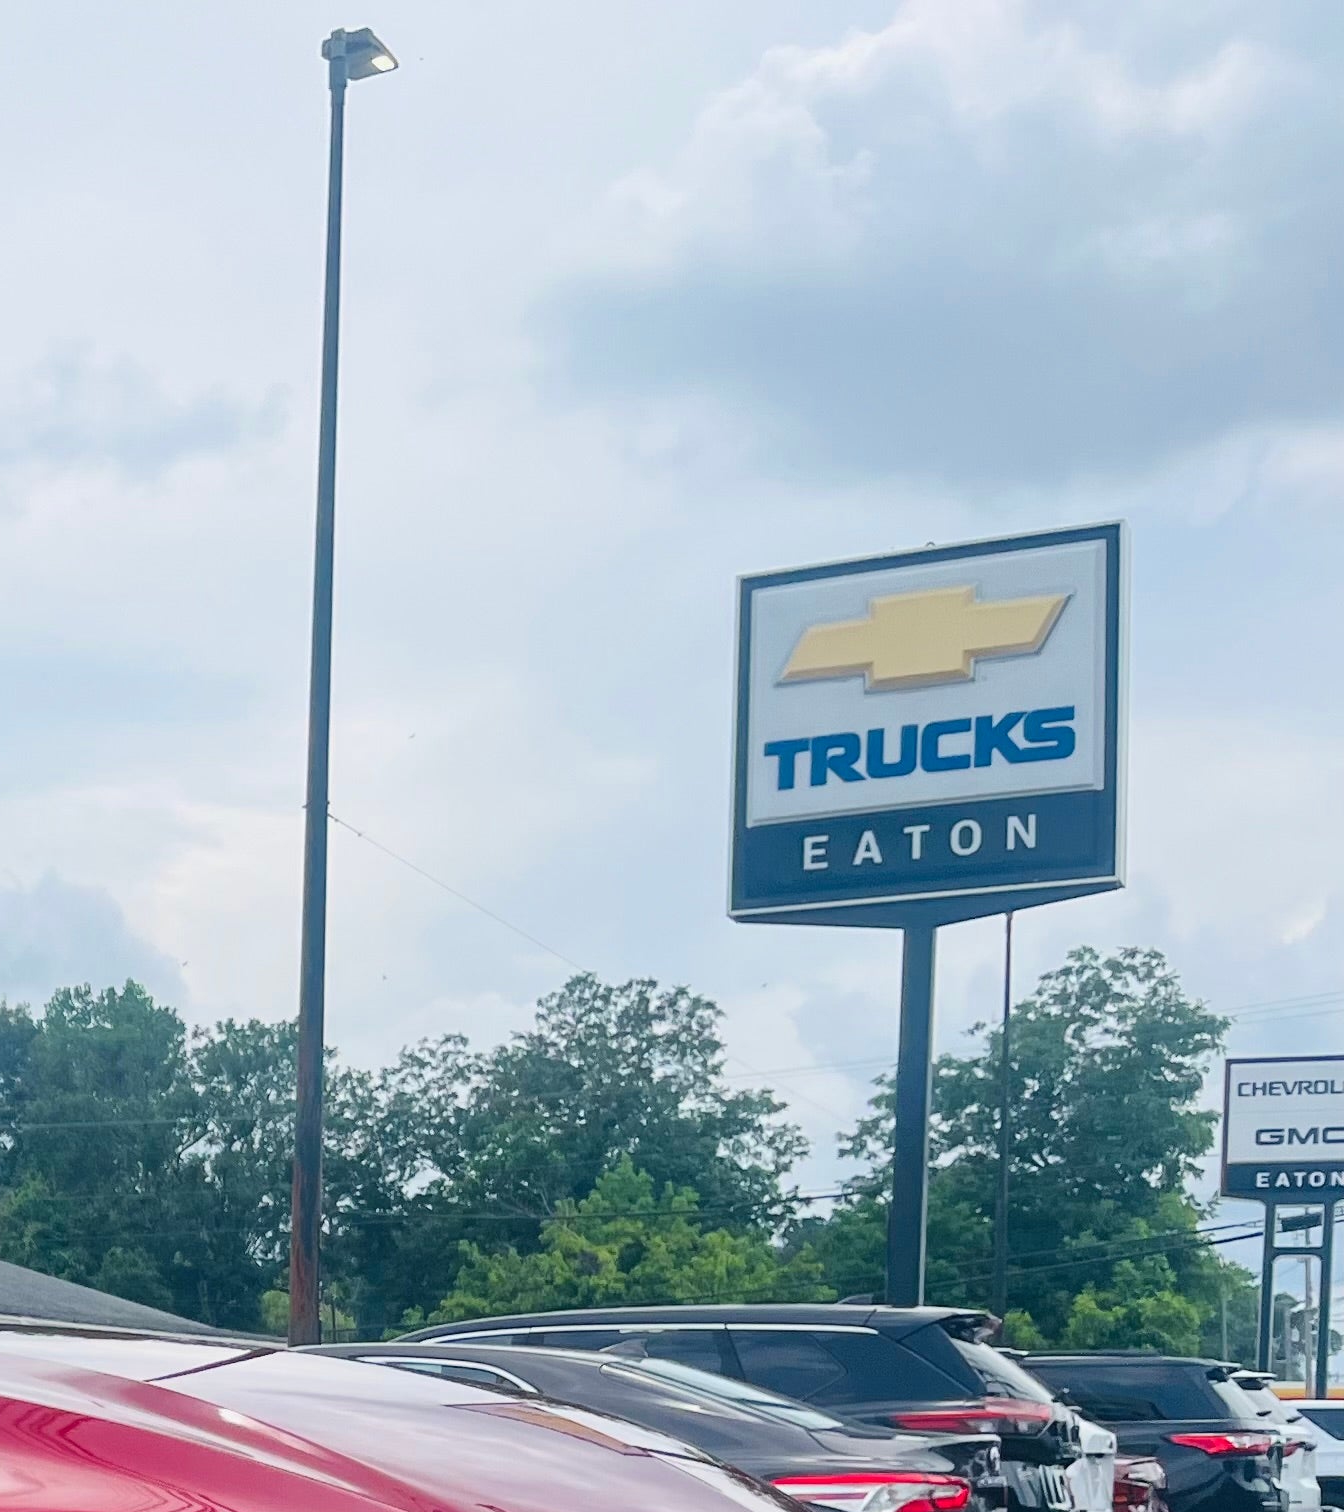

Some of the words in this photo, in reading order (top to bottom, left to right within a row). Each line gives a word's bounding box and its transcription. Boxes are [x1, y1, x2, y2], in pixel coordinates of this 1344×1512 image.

[764, 705, 1076, 791] TRUCKS
[802, 813, 1038, 871] EATON
[1255, 1126, 1344, 1146] GMC
[1255, 1170, 1344, 1189] EATON
